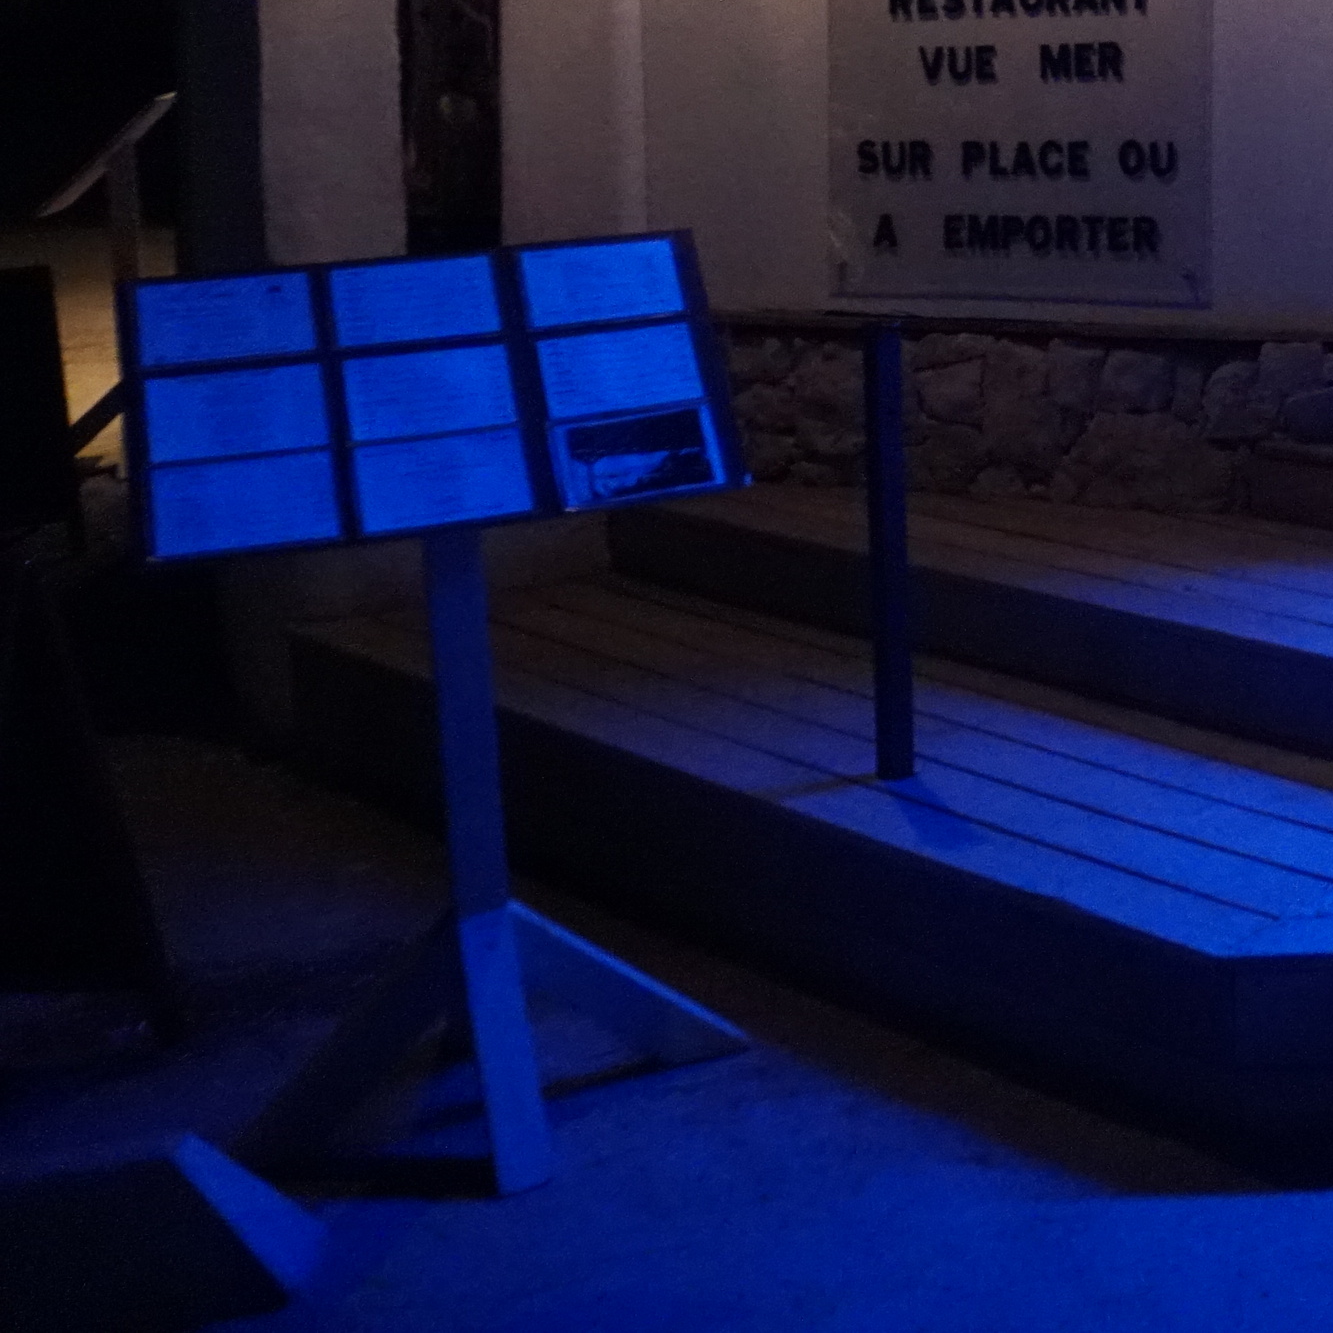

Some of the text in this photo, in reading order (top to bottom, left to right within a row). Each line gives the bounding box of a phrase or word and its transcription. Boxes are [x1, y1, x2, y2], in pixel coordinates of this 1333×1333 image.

[919, 42, 1123, 84] VUE MER
[857, 140, 1179, 178] SUR PLACE OU
[873, 214, 1159, 253] A EMPORTER
